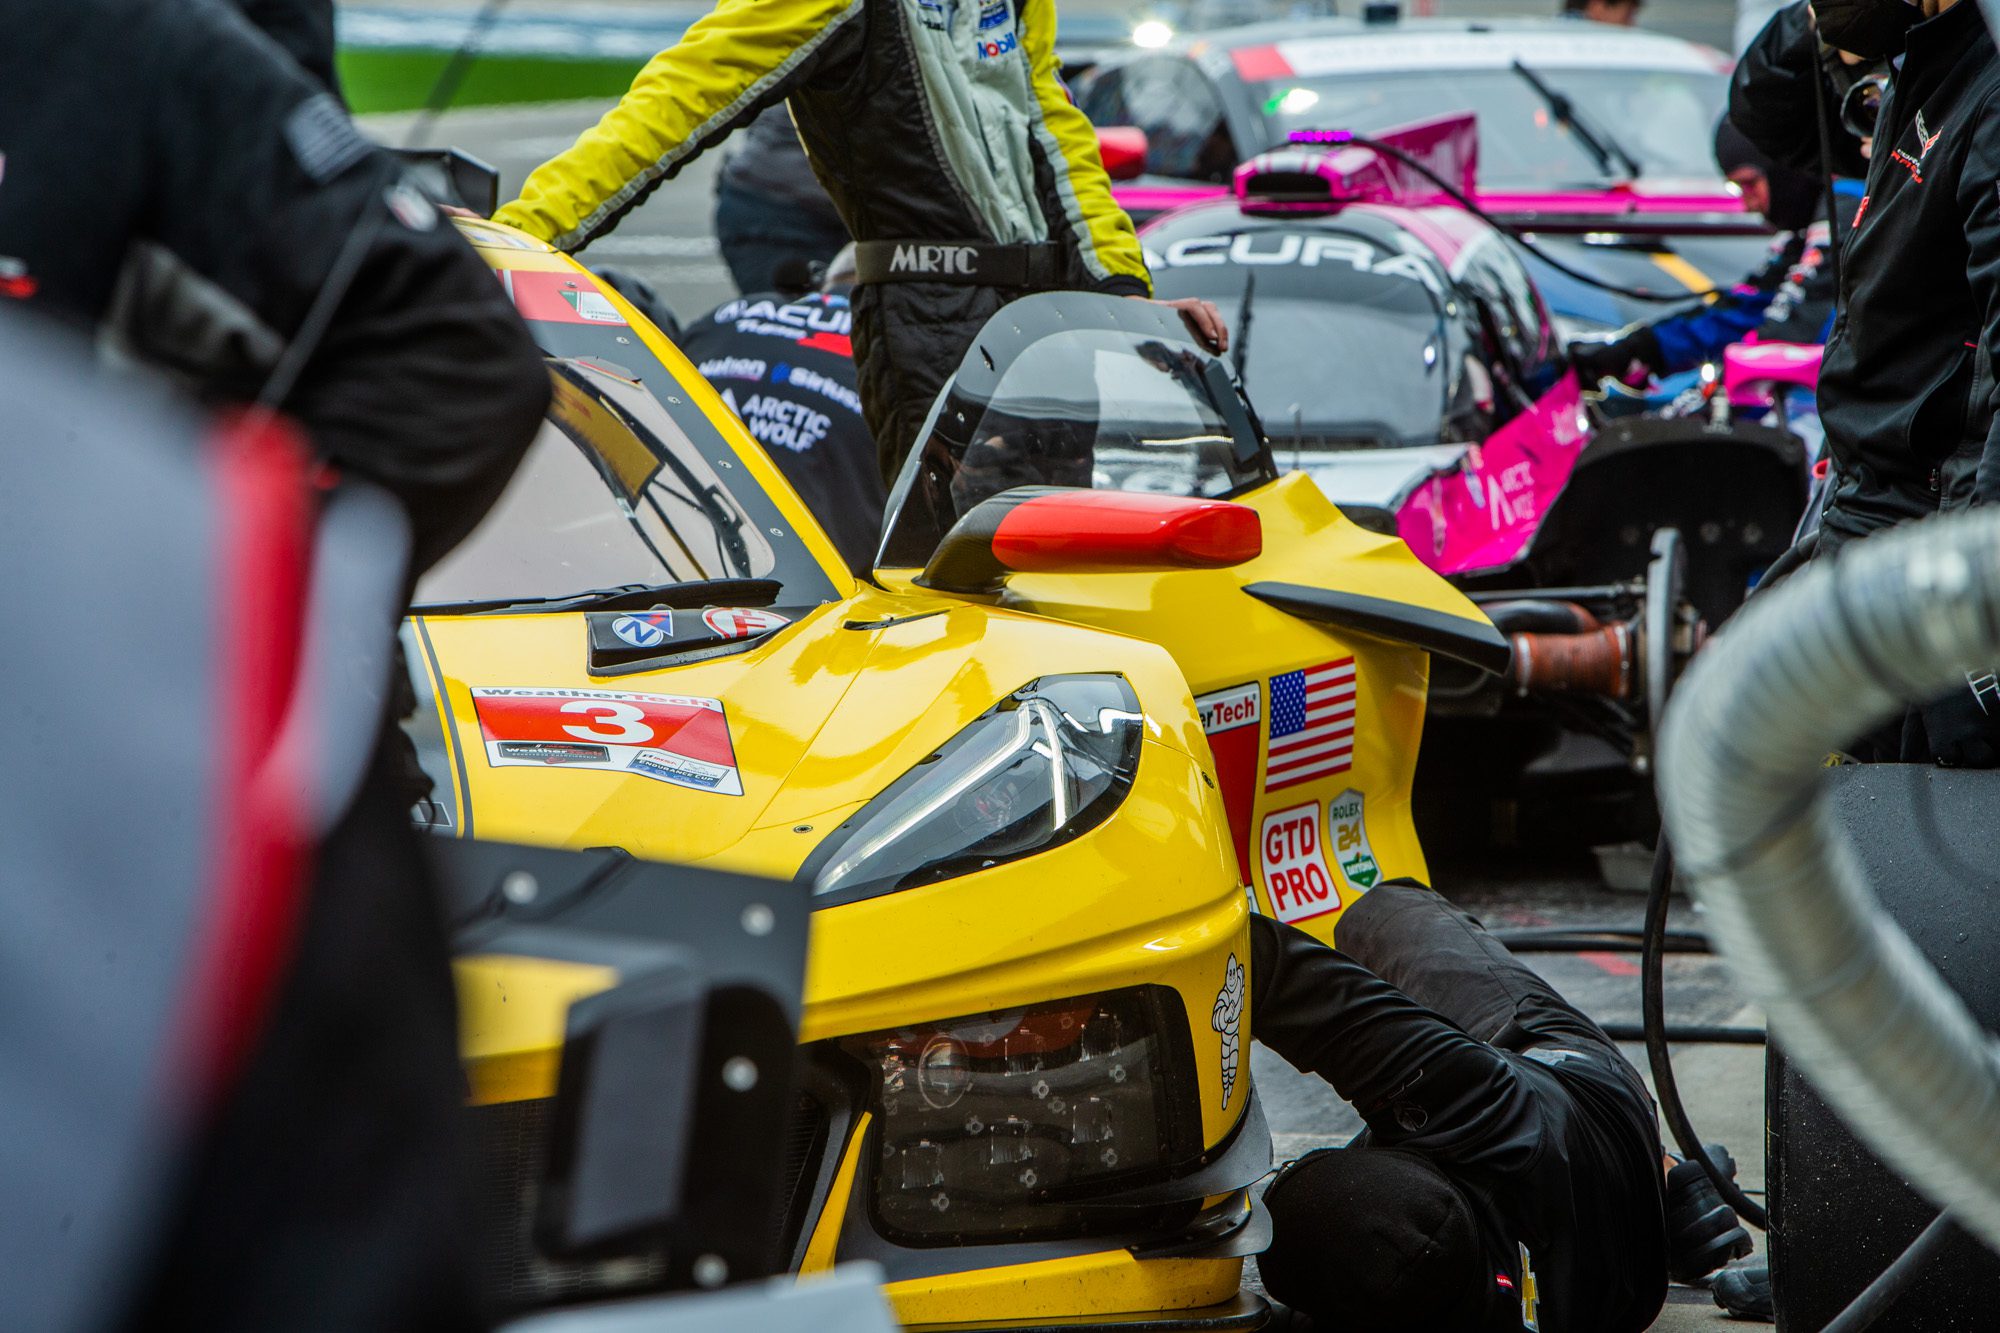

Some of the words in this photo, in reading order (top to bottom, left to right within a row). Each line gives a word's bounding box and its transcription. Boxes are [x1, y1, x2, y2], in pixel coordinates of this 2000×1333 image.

[978, 32, 1016, 60] Mobil
[889, 244, 979, 275] MRTC
[741, 394, 832, 440] ARCTIC
[749, 416, 817, 453] WOLF
[482, 688, 712, 708] WeatherTech
[560, 700, 655, 744] 3
[506, 747, 603, 756] WeatherTech
[639, 760, 694, 778] ENDURANCE
[695, 773, 714, 781] CUP
[1332, 801, 1361, 821] ROLEX
[1265, 815, 1315, 865] GTD
[1337, 819, 1361, 851] 24
[1270, 862, 1329, 911] PRO
